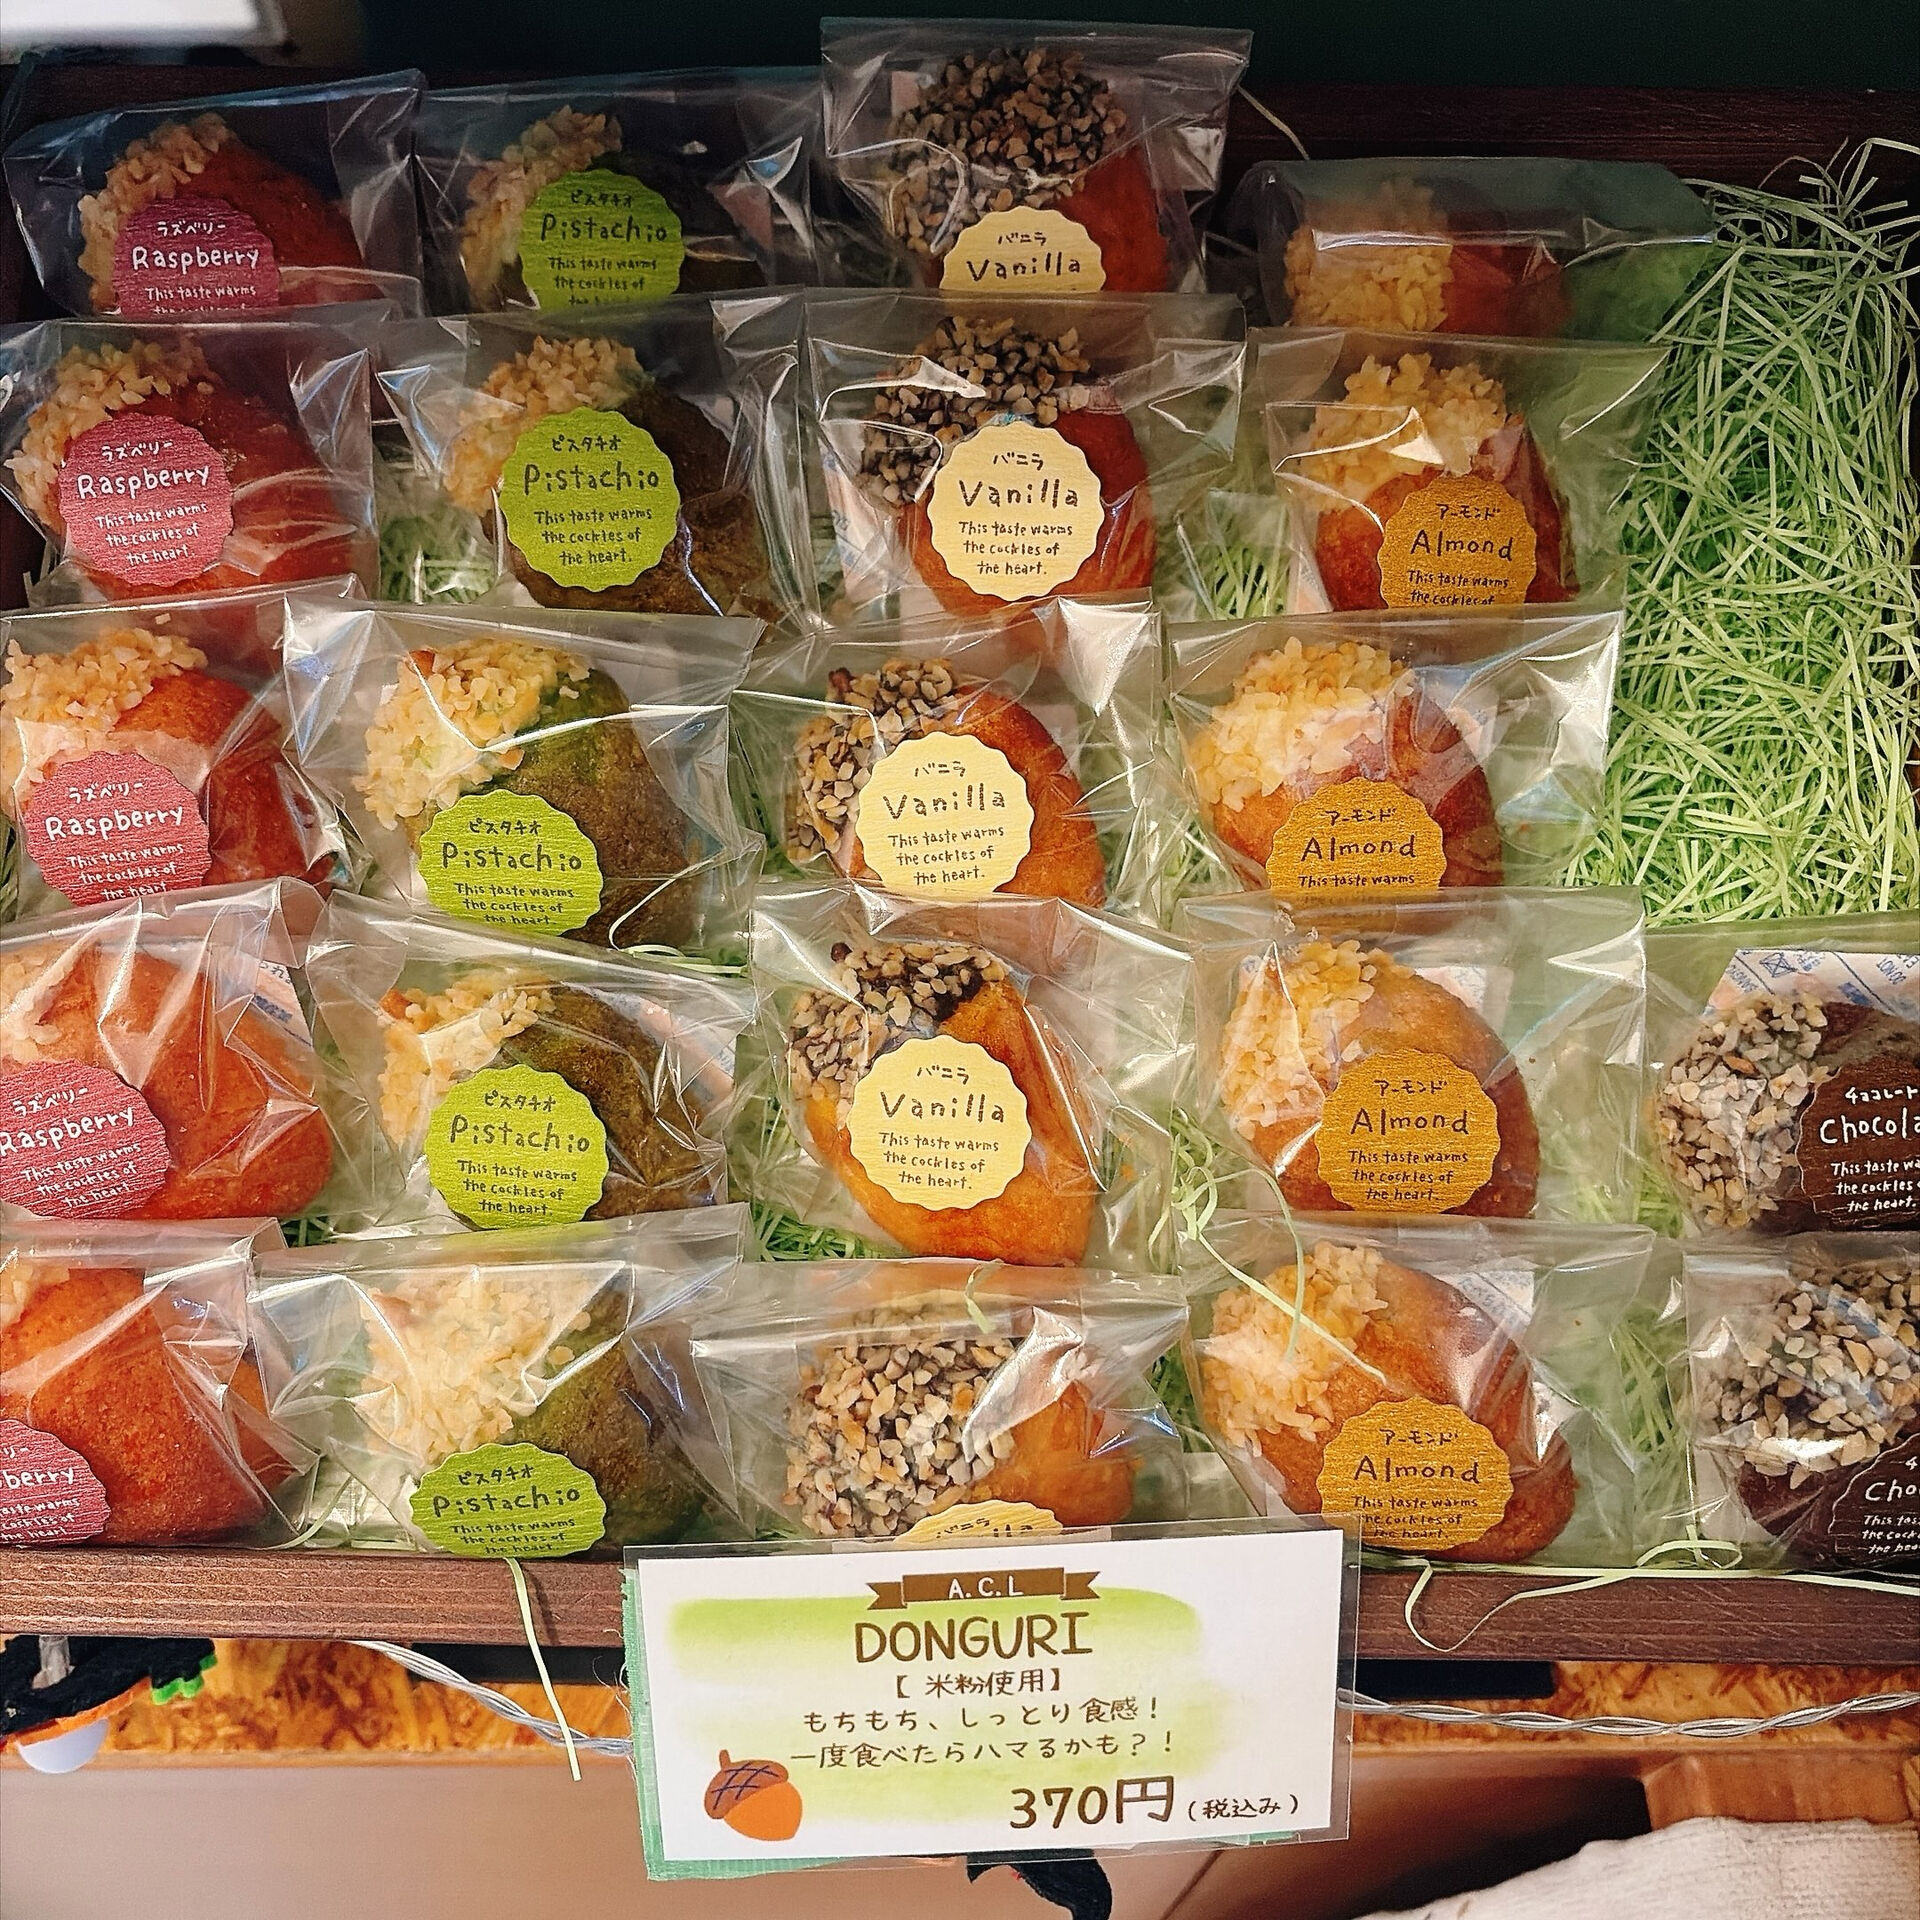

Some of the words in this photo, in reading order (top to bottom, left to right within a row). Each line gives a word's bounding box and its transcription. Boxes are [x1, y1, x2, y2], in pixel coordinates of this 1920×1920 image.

[571, 189, 632, 208] ピスタチオ
[158, 219, 225, 236] ラズベリー
[541, 213, 667, 242] Pistachio
[998, 232, 1046, 246] バニラ
[132, 246, 259, 274] Raspberry
[548, 257, 576, 270] This
[581, 258, 612, 270] taste
[617, 260, 656, 269] warms
[967, 252, 1080, 282] Vanilla
[145, 288, 173, 301] This
[178, 287, 211, 299] taste
[216, 286, 256, 295] warms
[102, 441, 173, 462] ラズベリー
[552, 434, 621, 452] ピスタチオ
[993, 452, 1043, 471] バニラ
[77, 465, 209, 499] Raspberry
[524, 461, 659, 496] Pistachio
[959, 479, 1078, 508] Vanilla
[95, 515, 124, 529] This
[128, 510, 161, 525] taste
[166, 503, 207, 518] warms
[534, 510, 565, 525] This
[568, 509, 604, 524] taste
[609, 508, 652, 521] warms
[1436, 504, 1500, 520] アーモンド
[106, 533, 128, 547] the
[133, 528, 182, 545] cockles
[186, 522, 199, 536] of
[542, 531, 564, 544] the
[570, 530, 622, 542] cockles
[628, 527, 642, 542] of
[959, 521, 987, 536] This
[992, 521, 1027, 536] taste
[1031, 525, 1073, 536] warms
[963, 540, 985, 554] the
[990, 542, 1040, 555] cockles
[1046, 543, 1060, 556] of
[1410, 529, 1513, 561] Almond
[126, 553, 149, 566] the
[152, 544, 195, 562] heart.
[560, 552, 582, 566] the
[589, 548, 631, 563] heart.
[977, 561, 999, 575] the
[1006, 561, 1047, 575] heart.
[1408, 570, 1434, 584] This
[1438, 572, 1468, 586] taste
[1473, 578, 1508, 588] warms
[1411, 590, 1430, 604] the
[914, 760, 966, 777] バニラ
[69, 782, 144, 804] ラズベリー
[883, 783, 1005, 819] Vanilla
[45, 806, 183, 841] Raspberry
[469, 818, 541, 835] ピスタチオ
[1325, 808, 1396, 826] アーモンド
[888, 834, 919, 849] This
[923, 829, 957, 846] taste
[961, 827, 1004, 840] warms
[67, 855, 97, 869] This
[100, 850, 136, 865] taste
[140, 843, 184, 858] warms
[442, 842, 582, 872] Pistachio
[897, 853, 919, 866] the
[923, 849, 975, 864] cockles
[980, 845, 994, 859] of
[1301, 835, 1416, 861] Almond
[79, 873, 103, 885] the
[106, 866, 160, 883] cockles
[161, 862, 177, 875] of
[914, 871, 936, 885] the
[942, 866, 985, 883] heart.
[1298, 875, 1327, 888] This
[1333, 875, 1367, 887] taste
[1372, 875, 1415, 885] warms
[100, 889, 125, 900] the
[454, 883, 485, 896] This
[489, 884, 525, 897] taste
[530, 887, 574, 898] warms
[463, 900, 486, 910] the
[491, 902, 545, 912] cockles
[550, 903, 563, 913] of
[917, 1065, 969, 1085] バニラ
[1374, 1080, 1447, 1096] アーモンド
[13, 1087, 88, 1117] ラズベリー
[484, 1089, 556, 1112] ピスタチオ
[880, 1092, 1004, 1123] Vanilla
[1351, 1108, 1469, 1135] Almond
[0, 1107, 134, 1156] Raspberry
[450, 1114, 590, 1152] Pistachio
[879, 1132, 909, 1146] This
[914, 1135, 950, 1150] taste
[955, 1140, 999, 1151] warms
[21, 1165, 54, 1182] This
[57, 1155, 93, 1175] taste
[96, 1143, 142, 1163] warms
[884, 1151, 906, 1165] the
[912, 1156, 965, 1171] cockles
[970, 1159, 985, 1173] of
[1349, 1151, 1378, 1164] This
[1384, 1150, 1419, 1164] taste
[1424, 1152, 1468, 1163] warms
[458, 1160, 487, 1175] This
[492, 1163, 528, 1178] taste
[533, 1169, 577, 1182] warms
[1352, 1170, 1375, 1181] the
[1380, 1170, 1433, 1183] cockles
[1439, 1171, 1453, 1184] of
[1831, 1162, 1860, 1176] This
[1865, 1159, 1899, 1175] taste
[37, 1182, 60, 1196] the
[64, 1168, 120, 1191] cockles
[123, 1161, 138, 1175] of
[899, 1171, 921, 1184] the
[928, 1174, 972, 1189] heart.
[1836, 1183, 1857, 1195] the
[1862, 1180, 1913, 1193] cockles
[463, 1178, 486, 1192] the
[491, 1184, 545, 1198] cockles
[550, 1188, 565, 1200] of
[1366, 1188, 1388, 1200] the
[479, 1200, 502, 1212] the
[509, 1201, 552, 1216] heart.
[1847, 1201, 1868, 1212] the
[1874, 1196, 1916, 1211] heart.
[1380, 1429, 1458, 1445] アーモンド
[458, 1464, 534, 1485] ピスタチオ
[1354, 1455, 1479, 1484] Almond
[433, 1485, 580, 1517] Pistachio
[1352, 1496, 1382, 1508] This
[1389, 1496, 1426, 1508] taste
[1431, 1498, 1478, 1507] warms
[451, 1525, 482, 1533] This
[486, 1524, 523, 1532] taste
[529, 1518, 575, 1530] warms
[1386, 1515, 1441, 1524] cockles
[1448, 1514, 1463, 1523] of
[1864, 1515, 1891, 1525] This
[551, 1532, 565, 1540] of
[949, 1576, 1024, 1599] A.C.L
[855, 1611, 1093, 1663] DONGURI
[1010, 1776, 1174, 1829] 370円
[1188, 1794, 1299, 1822] （税込み）
